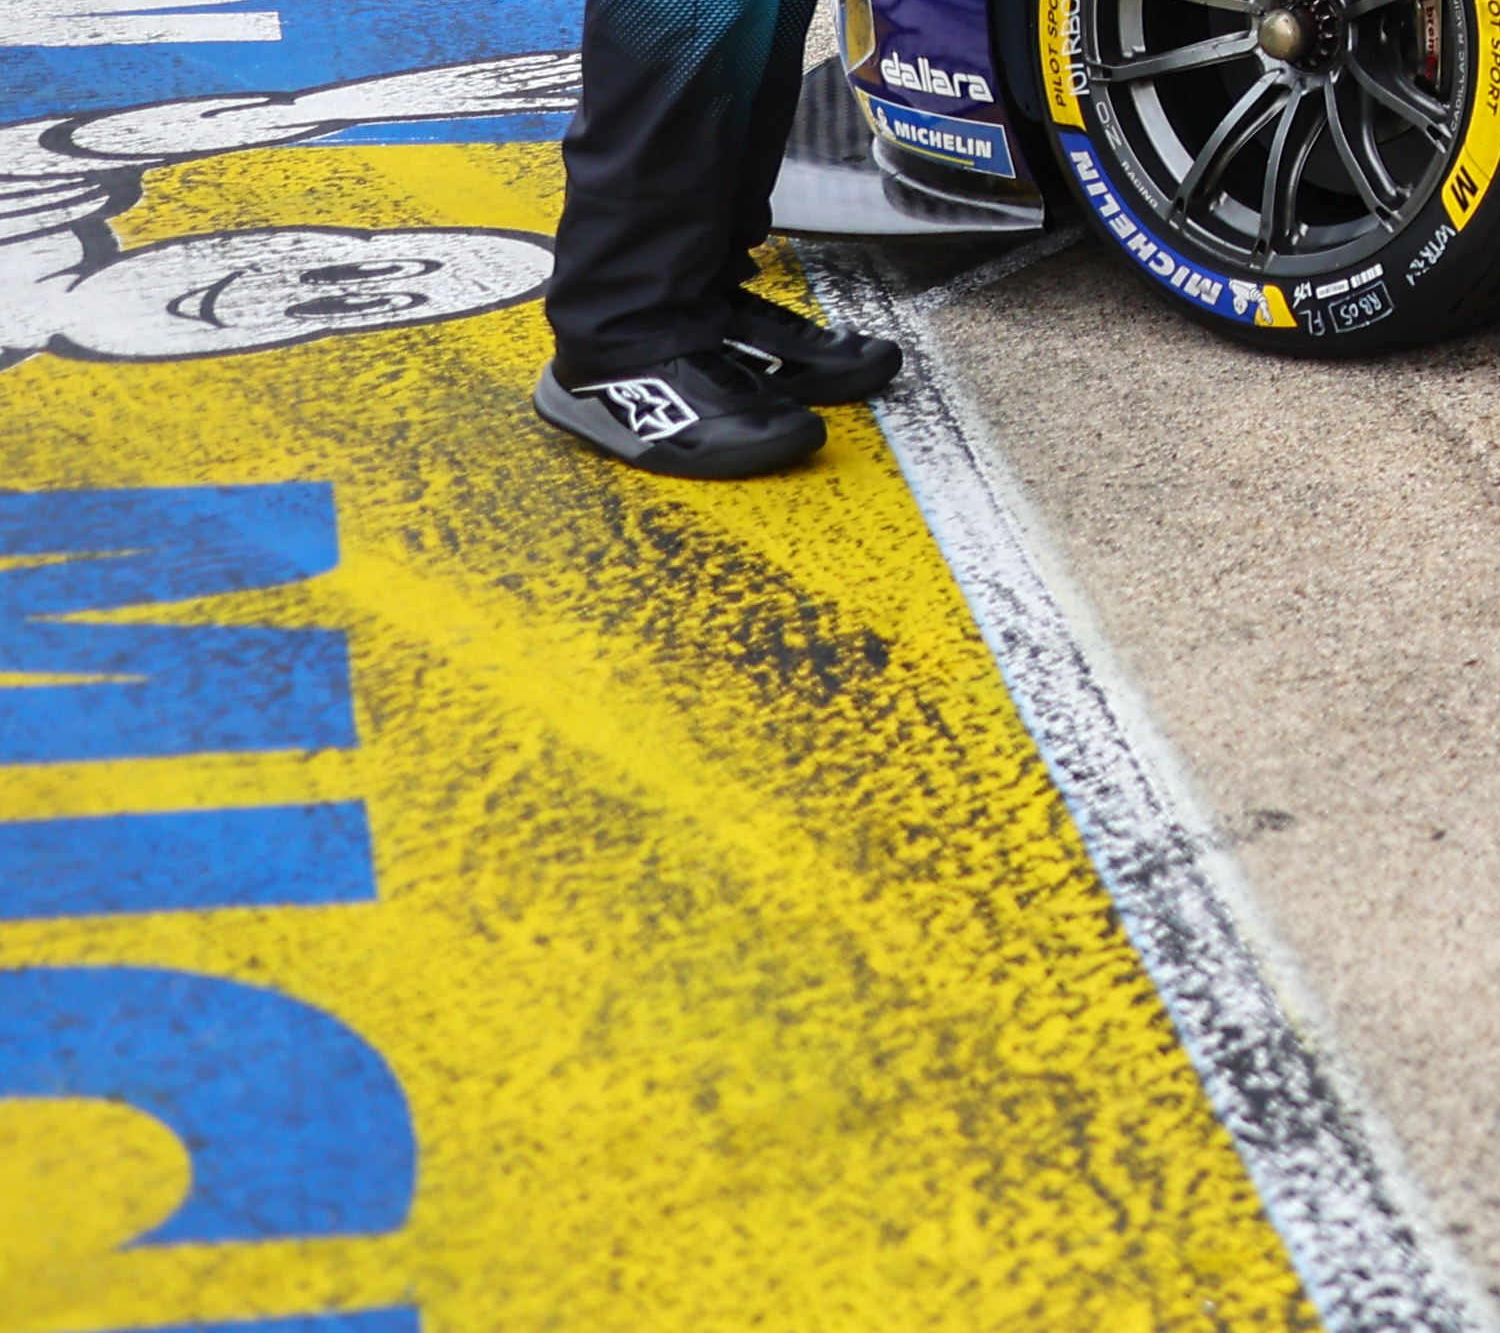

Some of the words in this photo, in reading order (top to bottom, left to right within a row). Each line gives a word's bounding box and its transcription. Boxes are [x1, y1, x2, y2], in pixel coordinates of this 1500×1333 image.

[881, 50, 995, 103] dallara
[1055, 42, 1069, 109] PILOT
[1450, 50, 1467, 132] CADILLAC
[893, 119, 993, 159] MICHELIN
[1449, 162, 1479, 214] M
[1070, 150, 1225, 308] MICHELIN
